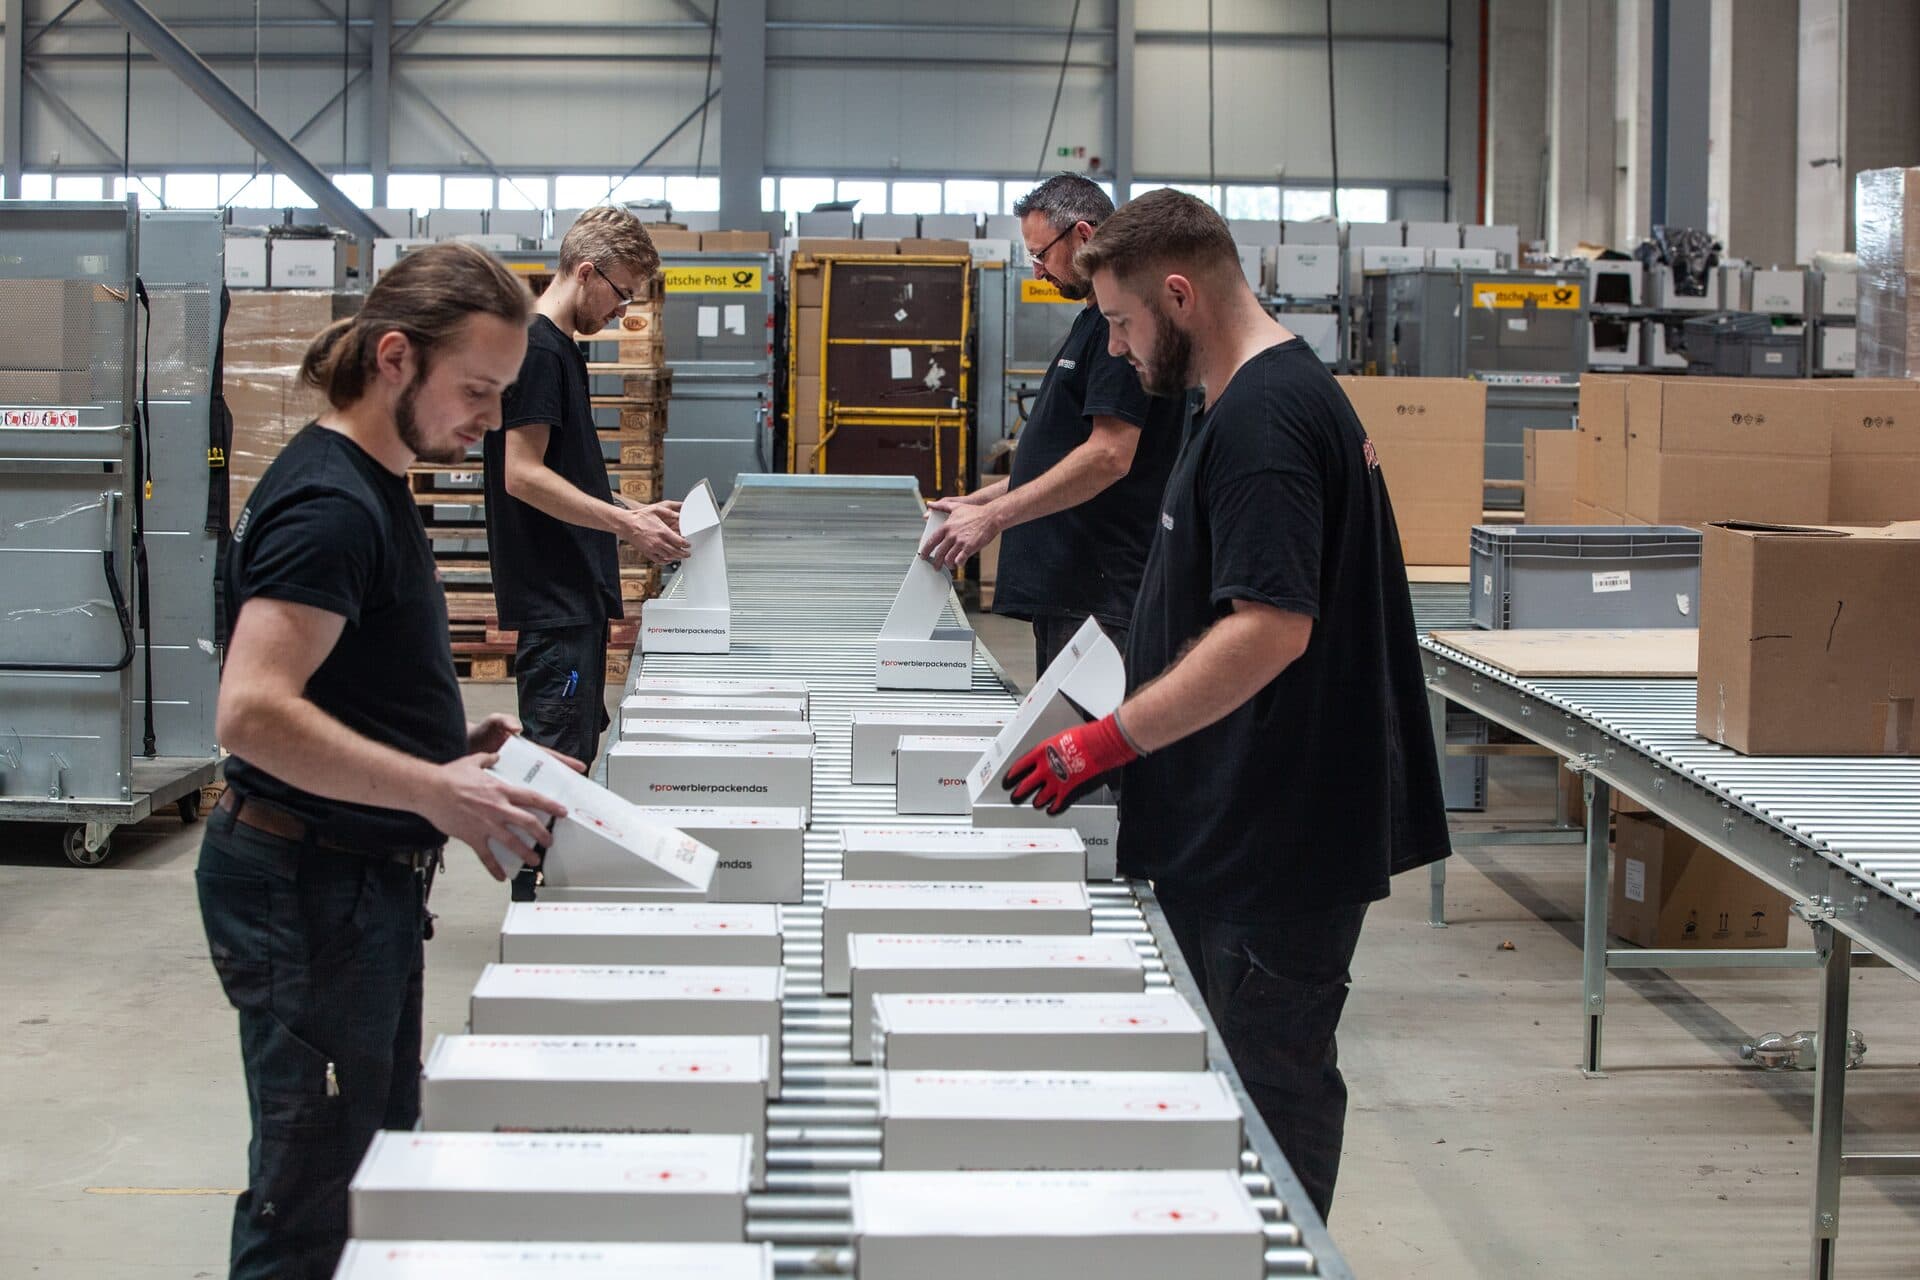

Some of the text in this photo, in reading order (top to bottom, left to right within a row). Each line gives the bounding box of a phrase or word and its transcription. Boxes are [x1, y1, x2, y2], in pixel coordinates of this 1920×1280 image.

[666, 274, 728, 286] utsche Post
[1029, 286, 1060, 296] Deuts
